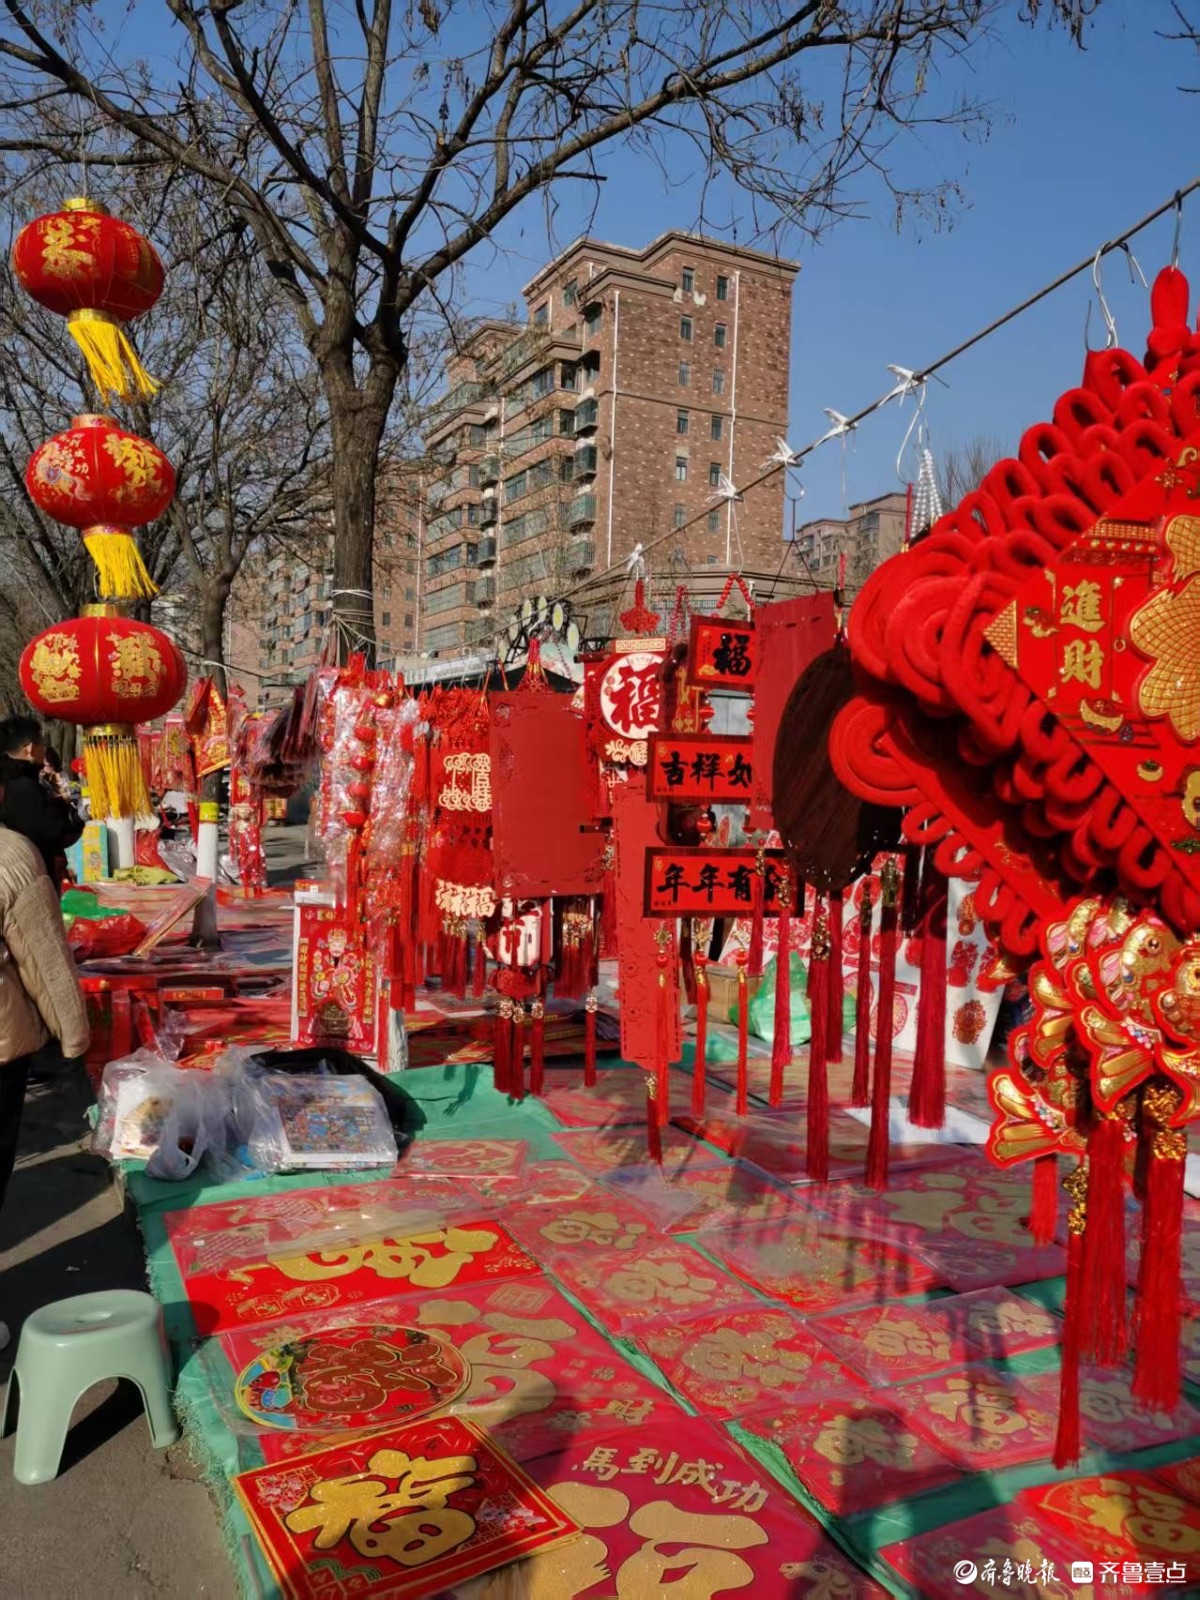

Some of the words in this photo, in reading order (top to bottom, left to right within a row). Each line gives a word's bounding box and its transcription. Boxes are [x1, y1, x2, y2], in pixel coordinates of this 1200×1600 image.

[713, 633, 752, 676] 福
[1060, 579, 1106, 690] 進財
[609, 662, 662, 734] 福
[924, 1378, 1029, 1434] 福
[285, 1448, 478, 1567] 福
[571, 1446, 770, 1513] 馬到成功
